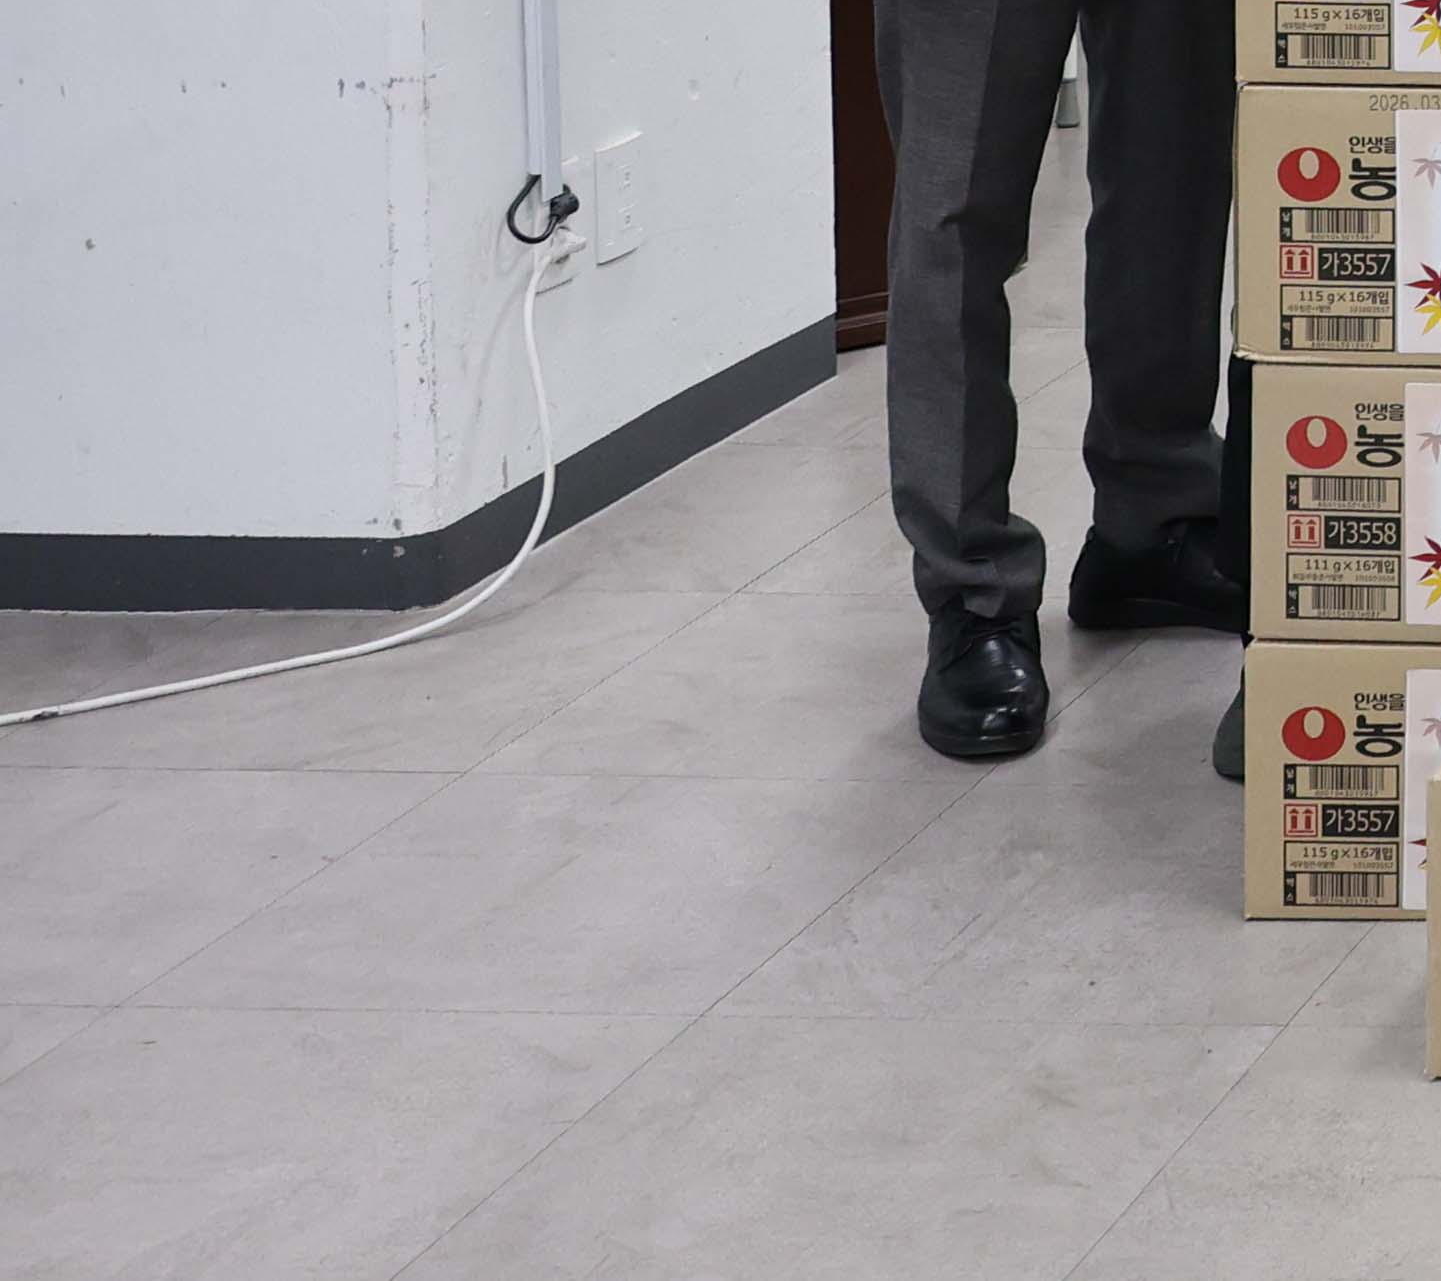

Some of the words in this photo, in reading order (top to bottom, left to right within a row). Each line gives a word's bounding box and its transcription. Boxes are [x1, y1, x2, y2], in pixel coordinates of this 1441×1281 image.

[1321, 251, 1392, 277] 가3557
[1354, 403, 1404, 421] 인생을
[1328, 520, 1397, 546] 가3558
[1325, 808, 1395, 833] 가3557
